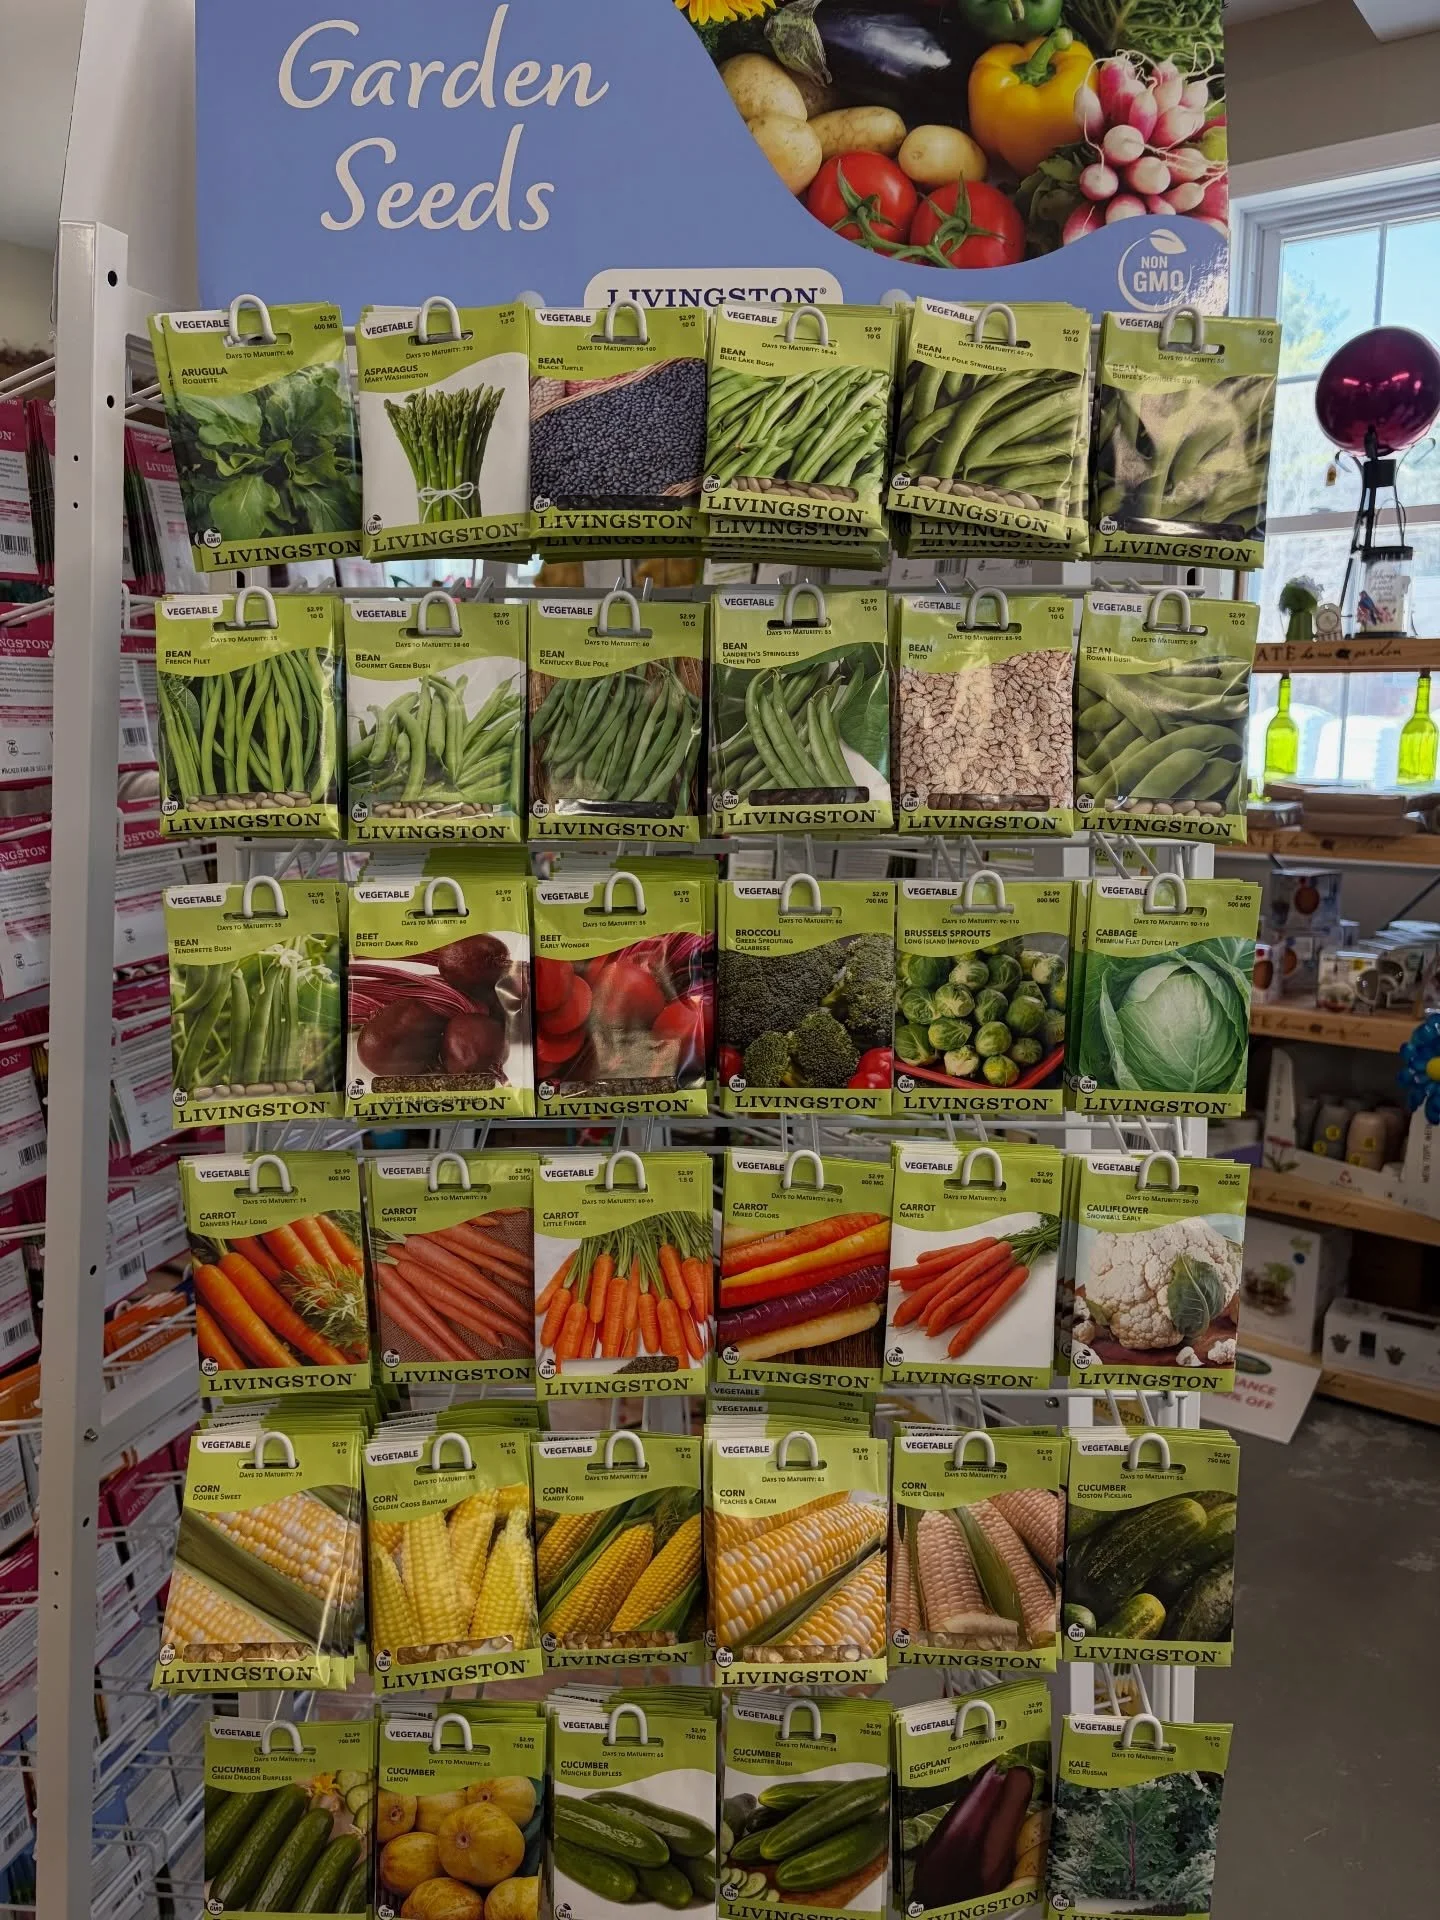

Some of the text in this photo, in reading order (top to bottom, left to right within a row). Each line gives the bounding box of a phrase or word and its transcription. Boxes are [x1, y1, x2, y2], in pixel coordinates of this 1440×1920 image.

[278, 3, 609, 109] Garden
[320, 123, 555, 232] Seeds
[1141, 256, 1168, 269] NON
[1133, 270, 1184, 292] GMO
[726, 310, 778, 325] VEGETABLE
[926, 303, 975, 322] VEGETABLE
[540, 313, 592, 324] VEGETABLE
[1119, 318, 1164, 329] VEGETABL
[176, 318, 230, 334] VEGETABLE
[366, 321, 414, 336] VEGETABLE
[720, 347, 747, 357] BEAN
[917, 343, 942, 354] BEAN
[538, 357, 564, 365] BEAN
[181, 366, 228, 377] ARUGULA
[364, 364, 419, 377] ASPARAGUS
[706, 495, 865, 525] LIVINGSTON
[894, 494, 1053, 533] LIVINGSTON
[538, 515, 694, 530] LIVINGSTON
[373, 523, 520, 553] LIVINGSTON
[214, 540, 362, 567] LIVINGSTON
[1104, 540, 1252, 562] LIVINGSTON
[725, 598, 774, 607] VEGETABLE
[913, 601, 961, 610] VEGETABLE
[1092, 601, 1142, 613] VEGETABLE
[167, 606, 219, 617] VEGETABLE
[356, 609, 407, 619] VEGETABLE
[542, 605, 593, 616] VEGETABLE
[722, 642, 749, 650] BEAN
[909, 644, 933, 652] BEAN
[1086, 646, 1111, 654] BEAN
[165, 650, 192, 658] BEAN
[355, 654, 381, 662] BEAN
[540, 650, 565, 658] BEAN
[168, 813, 321, 833] LIVINGSTON
[728, 810, 877, 827] LIVINGSTON
[906, 815, 1059, 831] LIVINGSTON
[538, 822, 687, 838] LIVINGSTON
[1080, 815, 1233, 837] LIVINGSTON
[357, 825, 507, 840] LIVINGSTON
[358, 889, 409, 900] VEGETABLE
[541, 891, 589, 901] VEGETABLE
[738, 887, 782, 895] VEGETABL
[907, 887, 958, 896] VEGETABLE
[171, 894, 222, 906] VEGETABLE
[356, 932, 378, 941] BEET
[540, 934, 562, 942] BEET
[736, 929, 781, 937] BROCCOLI
[904, 929, 991, 937] BRUSSELS SPROUTS
[1095, 928, 1138, 938] CABBAGE
[174, 938, 199, 947] BEAN
[354, 1099, 508, 1118] LIVINGSTON
[735, 1096, 878, 1110] LIVINGSTON
[903, 1097, 1049, 1112] LIVINGSTON
[1083, 1098, 1227, 1115] LIVINGSTON
[178, 1101, 326, 1124] LIVINGSTON
[544, 1100, 690, 1118] LIVINGSTON
[382, 1166, 431, 1176] VEGETABLE
[736, 1161, 785, 1171] VEGETABLE
[904, 1162, 953, 1171] VEGETABLE
[1092, 1163, 1141, 1173] VEGETABLE
[200, 1169, 250, 1179] VEGETABLE
[545, 1168, 594, 1178] VEGETABLE
[381, 1207, 418, 1216] CARROT
[733, 1202, 769, 1211] CARROT
[900, 1203, 936, 1211] CARROT
[1087, 1204, 1149, 1214] CAULIFLOWER
[199, 1211, 236, 1220] CARROT
[542, 1211, 579, 1220] CARROT
[389, 1367, 532, 1384] LIVINGSTON
[727, 1368, 870, 1389] LIVINGSTON
[890, 1370, 1035, 1389] LIVINGSTON
[1079, 1371, 1218, 1389] LIVINGSTON
[208, 1373, 352, 1393] LIVINGSTON
[545, 1377, 690, 1396] LIVINGSTON
[714, 1386, 761, 1395] VEGETABLE
[716, 1404, 764, 1413] VEGETABLE
[201, 1440, 251, 1449] VEGETABLE
[543, 1445, 593, 1455] VEGETABLE
[722, 1445, 770, 1455] VEGETABLE
[906, 1441, 954, 1450] VEGETABLE
[1081, 1444, 1130, 1453] VEGETABLE
[370, 1449, 419, 1463] VEGETABLE
[194, 1485, 221, 1494] CORN
[542, 1486, 568, 1495] CORN
[901, 1481, 927, 1490] CORN
[1077, 1484, 1127, 1493] CUCUMBER
[720, 1489, 746, 1498] CORN
[373, 1494, 398, 1505] CORN
[1073, 1645, 1218, 1663] LIVINGSTON
[546, 1652, 689, 1668] LIVINGSTON
[898, 1651, 1043, 1670] LIVINGSTON
[160, 1666, 314, 1686] LIVINGSTON
[383, 1659, 527, 1689] LIVINGSTON
[721, 1669, 869, 1687] LIVINGSTON
[737, 1709, 784, 1722] VEGETABLE
[563, 1721, 610, 1731] VEGETABLE
[911, 1719, 956, 1733] VEGETABLE
[1074, 1722, 1122, 1732] VEGETABLE
[214, 1728, 261, 1738] VEGETABLE
[389, 1730, 433, 1739] VEGETABL
[733, 1748, 782, 1759] CUCUMBER
[561, 1761, 609, 1770] CUCUMBER
[909, 1757, 952, 1773] EGGPLANT
[1068, 1760, 1091, 1769] KALE
[212, 1766, 261, 1775] CUCUMBER
[387, 1767, 436, 1777] CUCUMBER
